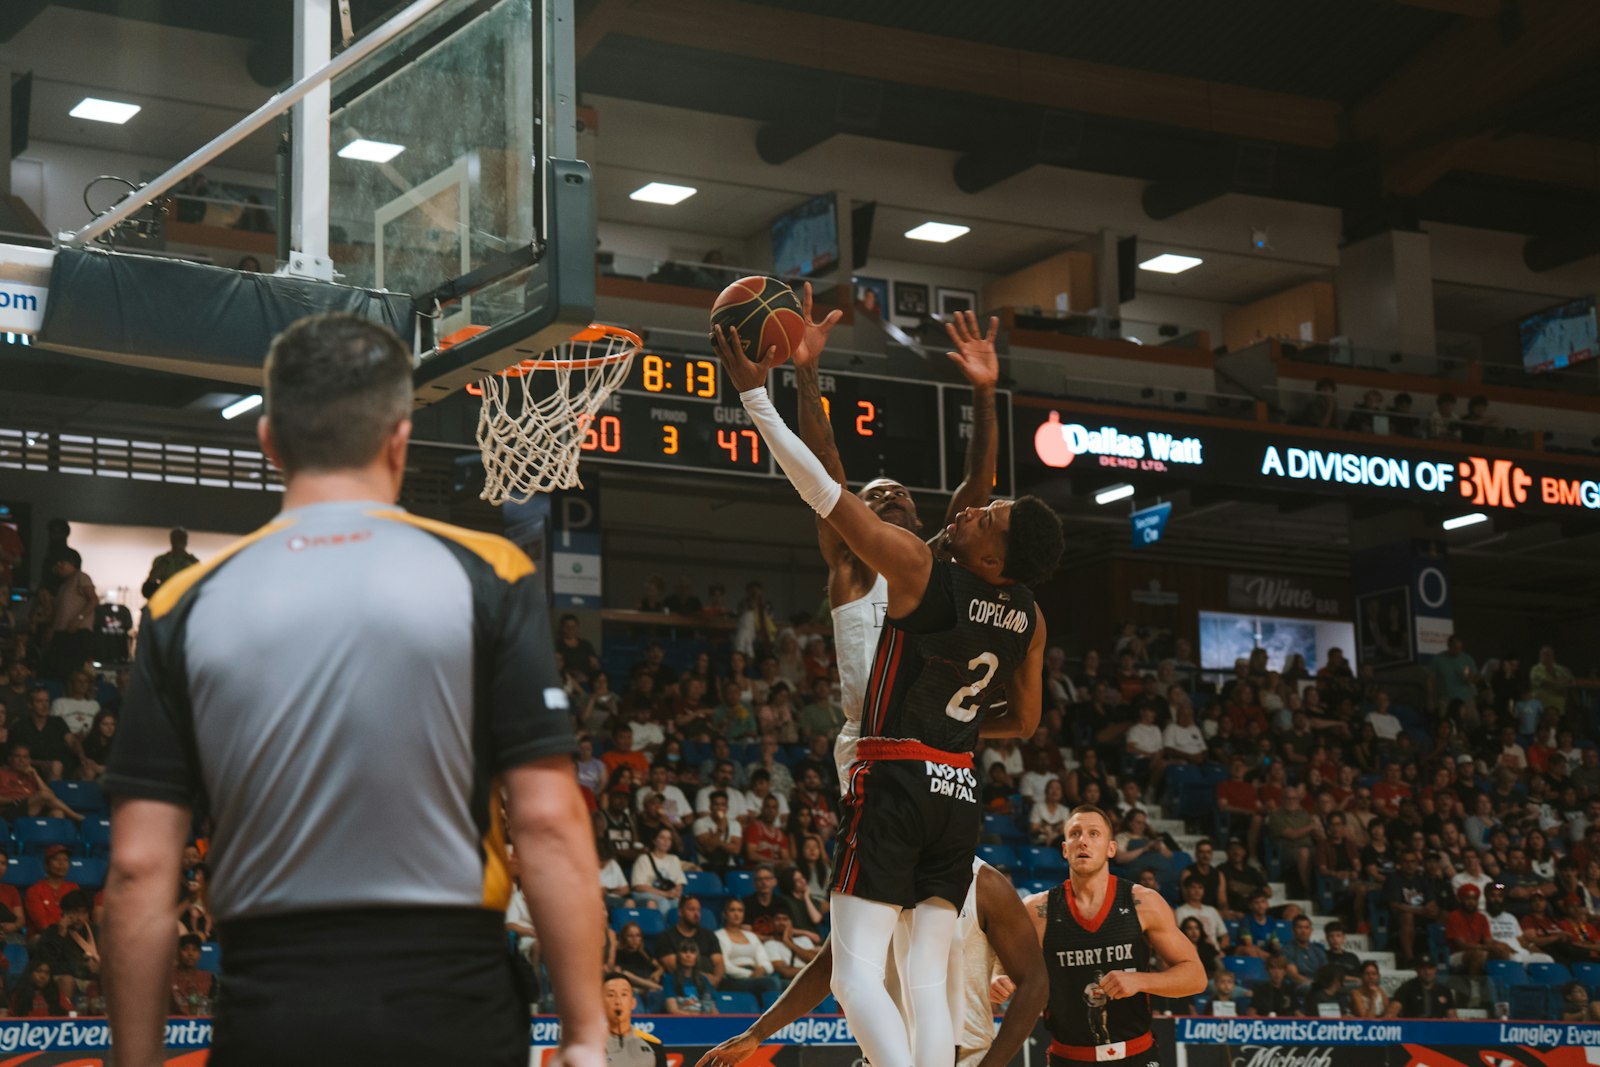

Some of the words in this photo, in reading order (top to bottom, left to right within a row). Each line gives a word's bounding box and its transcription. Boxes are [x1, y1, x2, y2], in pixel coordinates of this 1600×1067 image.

[643, 355, 716, 398] 8:13
[782, 371, 836, 392] PLER
[651, 408, 688, 423] PERIOD
[713, 406, 753, 425] GUES
[856, 400, 875, 436] 2
[663, 425, 679, 455] 3
[717, 430, 759, 464] 47
[1061, 424, 1145, 459] Dallas
[1147, 432, 1203, 464] Watt
[1099, 456, 1138, 469] DEMO
[1261, 446, 1285, 476] A
[1287, 448, 1410, 489] DIVISION
[1415, 461, 1454, 492] OF
[1541, 477, 1600, 509] BMG
[1246, 576, 1313, 610] Wine
[968, 598, 1028, 634] COPELAND
[945, 651, 999, 723] 2
[930, 777, 977, 804] DENTAL
[1056, 948, 1103, 967] TERRY
[1106, 943, 1133, 963] FOX
[1184, 1019, 1402, 1042] LangleyEventsCentre.com
[1500, 1023, 1562, 1046] Langley
